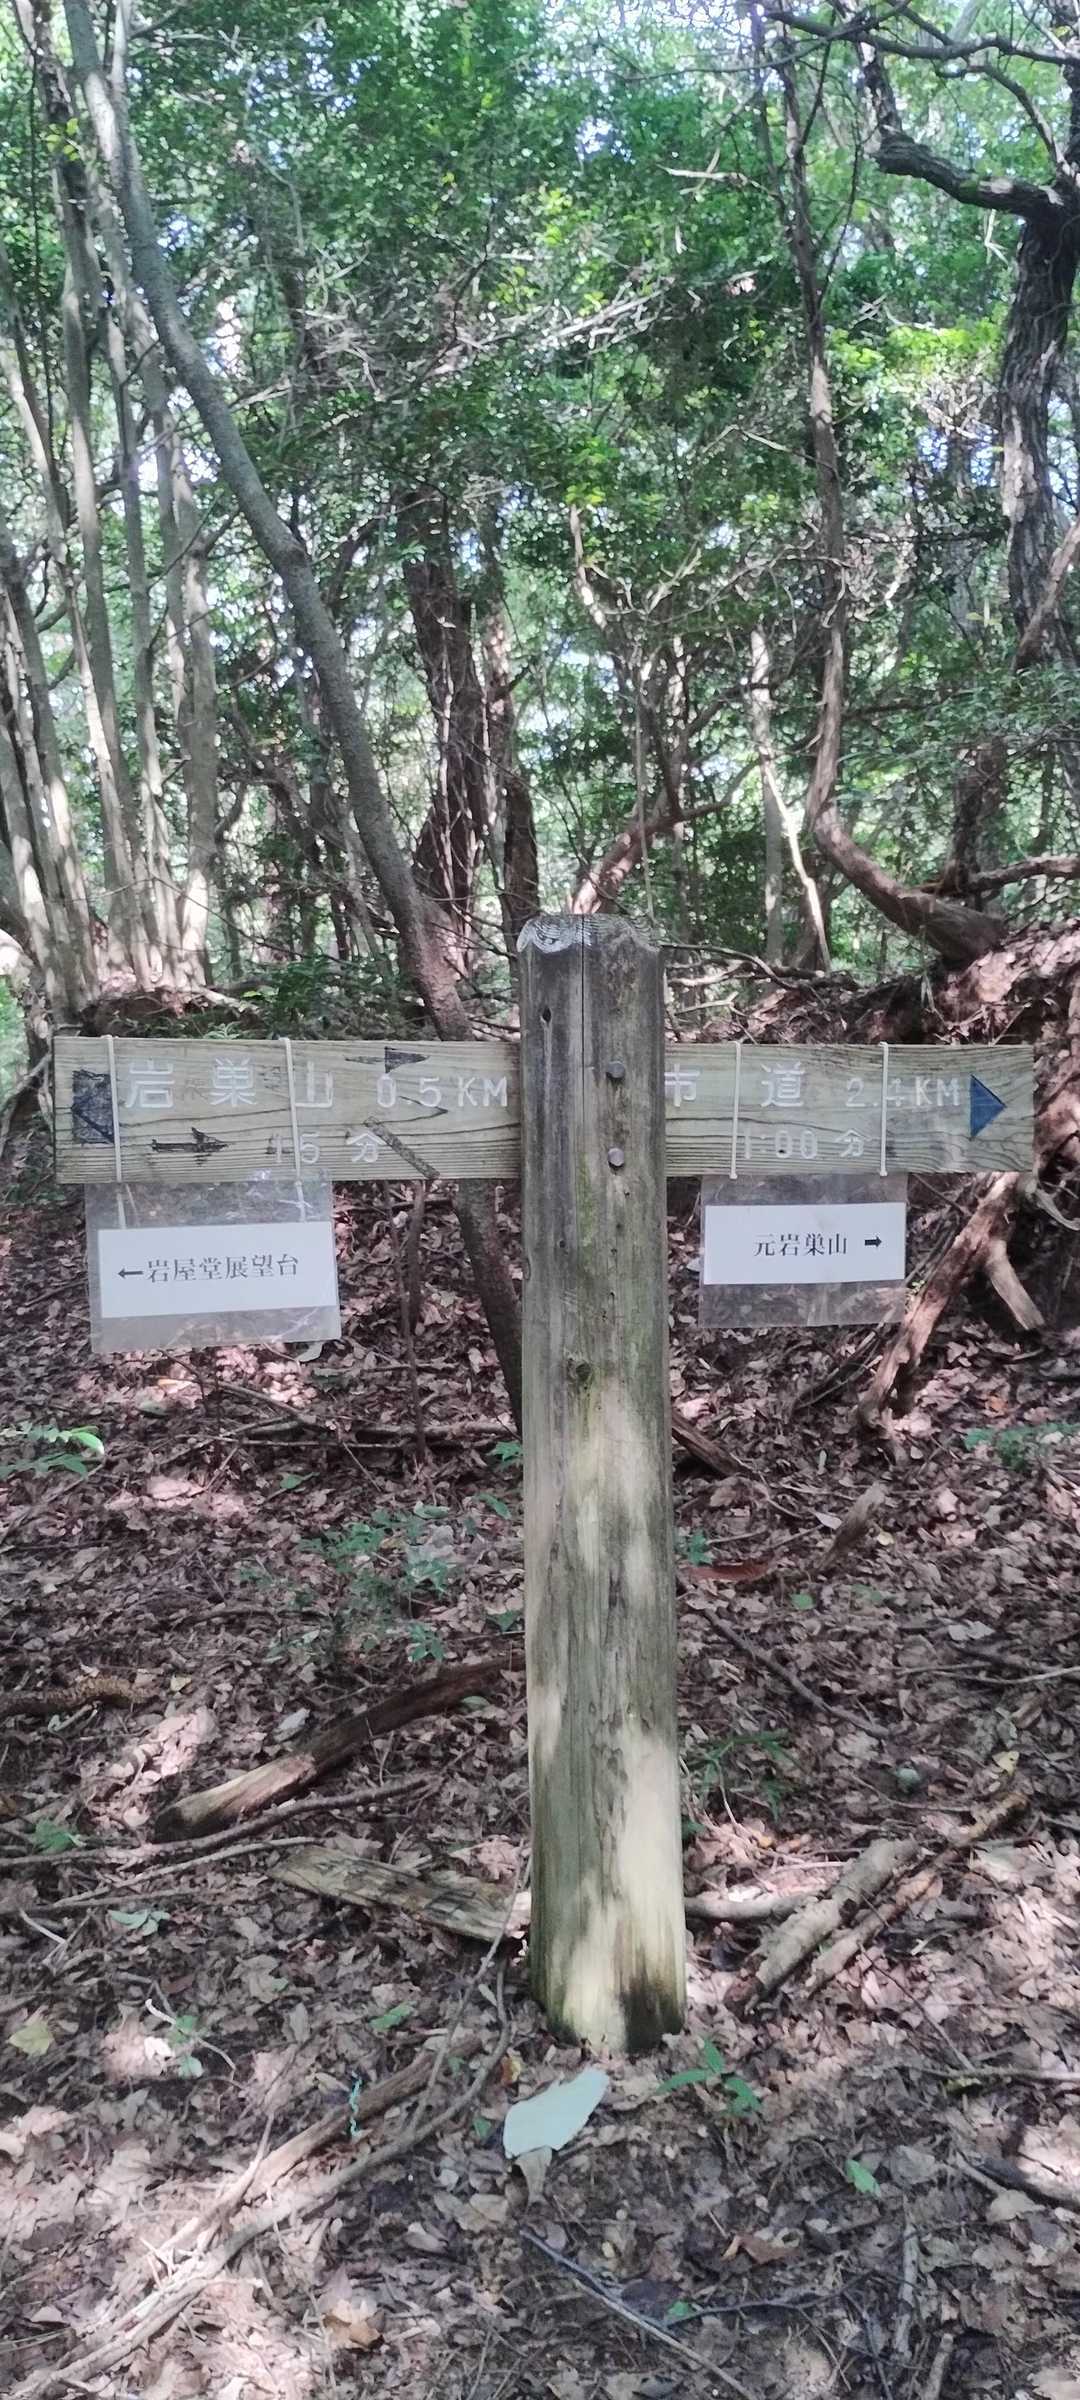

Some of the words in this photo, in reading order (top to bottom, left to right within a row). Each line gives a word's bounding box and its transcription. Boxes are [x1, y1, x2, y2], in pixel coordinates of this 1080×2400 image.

[125, 1058, 333, 1108] 岩巣山
[754, 1233, 847, 1257] 元岩巣山
[147, 1253, 299, 1283] 岩屋堂展望台
